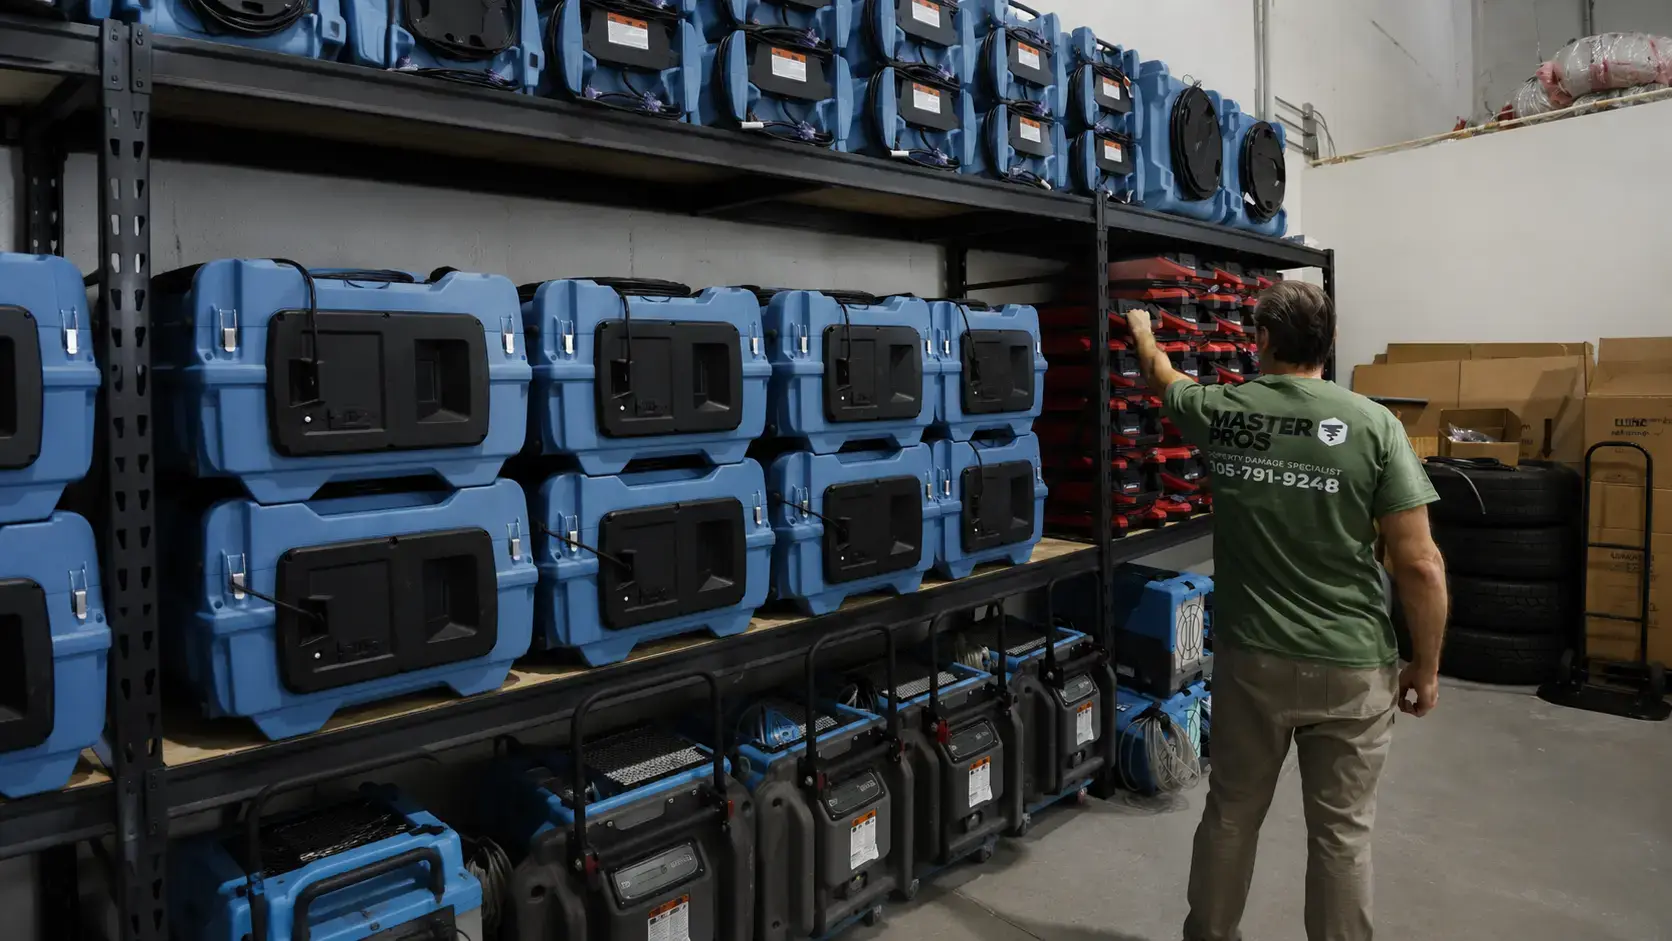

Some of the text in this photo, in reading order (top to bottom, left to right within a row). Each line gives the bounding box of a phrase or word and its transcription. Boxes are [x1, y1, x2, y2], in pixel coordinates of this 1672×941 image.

[1210, 410, 1313, 437] MASTER
[1209, 428, 1271, 451] PROS
[1245, 456, 1284, 467] DAMAGE
[1287, 461, 1342, 476] SPECIALIST
